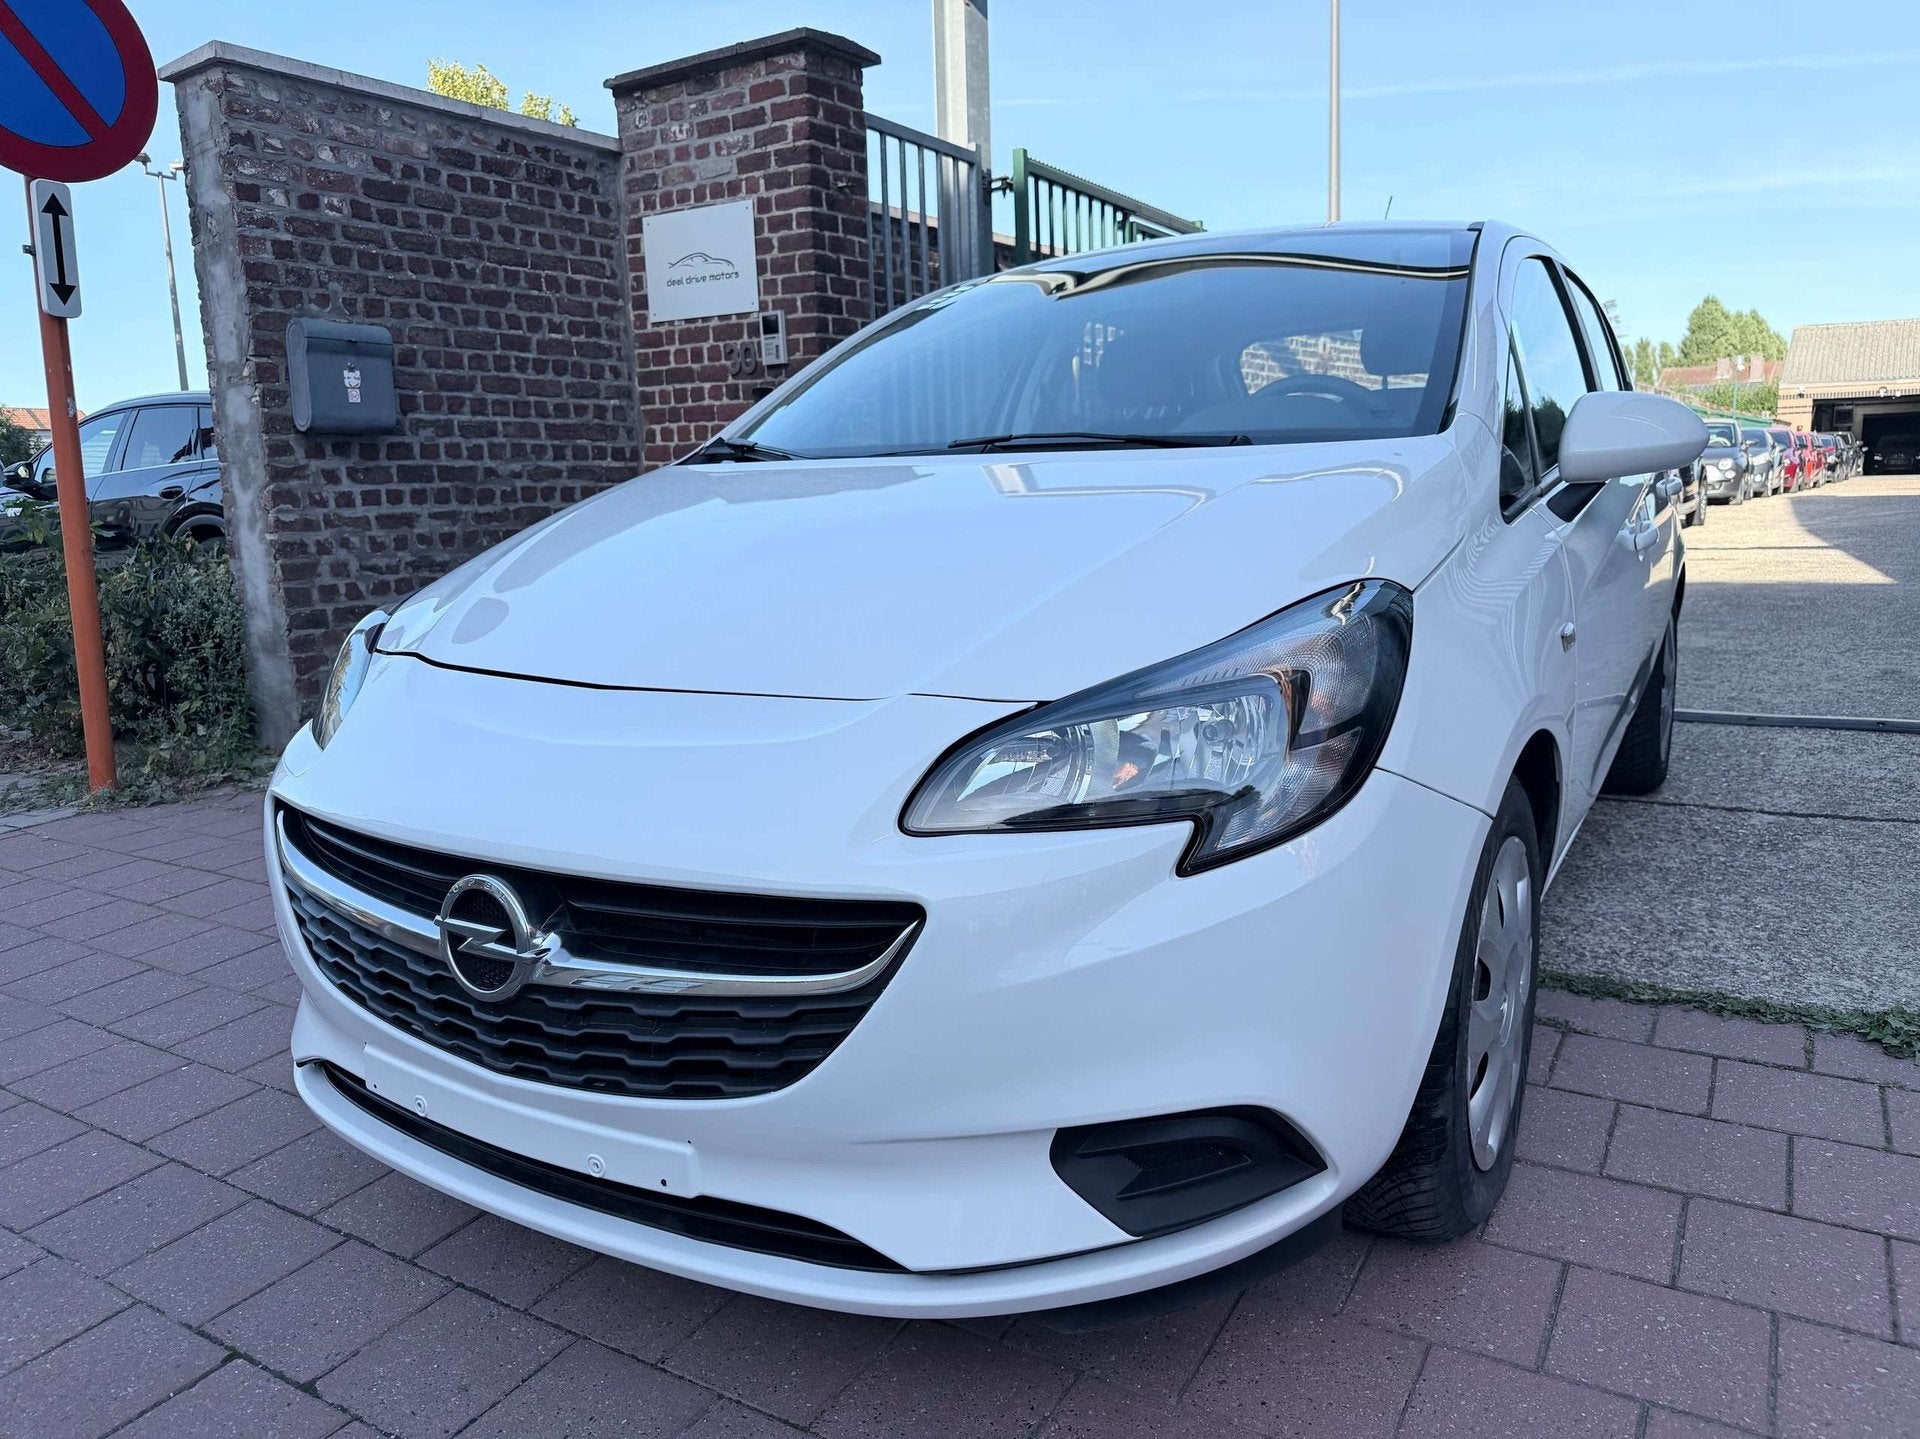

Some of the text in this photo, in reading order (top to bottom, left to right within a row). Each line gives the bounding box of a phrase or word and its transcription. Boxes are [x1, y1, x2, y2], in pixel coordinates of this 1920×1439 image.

[666, 271, 740, 287] deal drive motors
[723, 342, 757, 376] 30
[451, 878, 507, 904] OPEL
